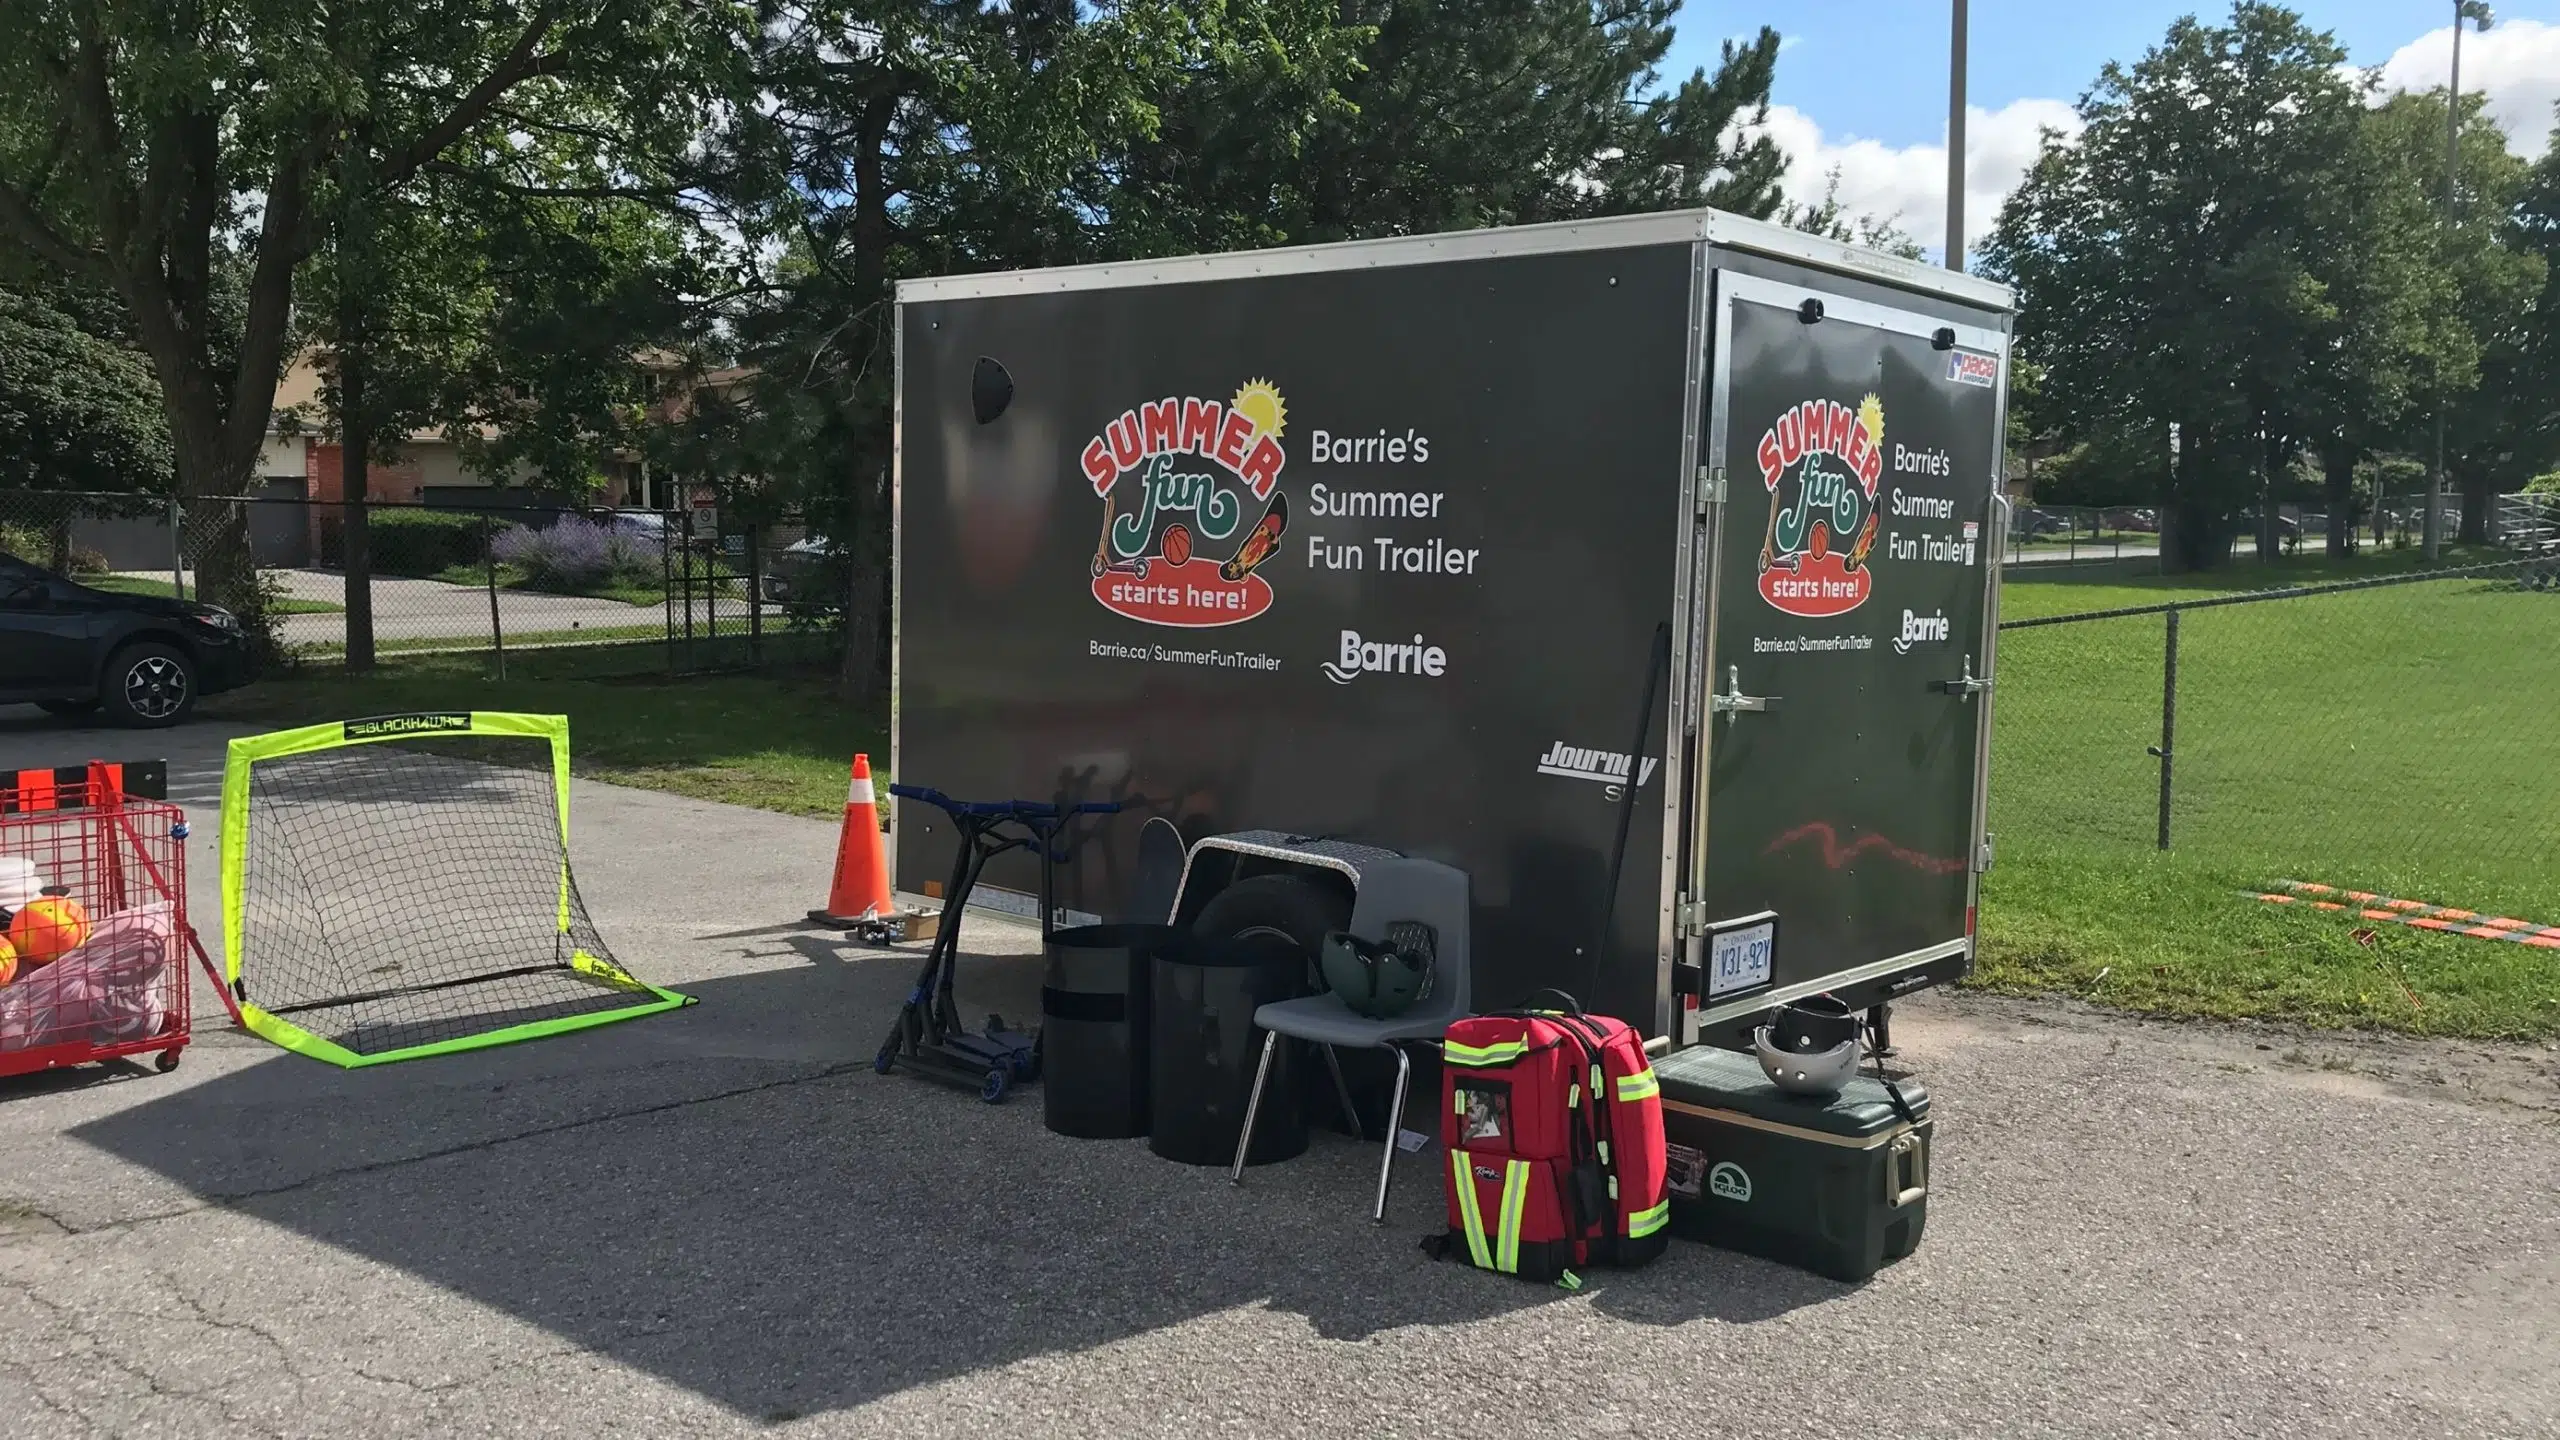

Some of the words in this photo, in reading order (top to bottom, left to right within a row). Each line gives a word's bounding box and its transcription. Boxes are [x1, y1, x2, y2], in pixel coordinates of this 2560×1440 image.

[1081, 397, 1286, 501] SUMMER
[1311, 428, 1429, 463] Barrie's
[1757, 399, 1882, 501] SUMMER
[1894, 443, 1950, 476] Barrie's
[1112, 454, 1240, 557] fun
[1309, 482, 1444, 518] Summer
[1776, 451, 1859, 552] fun
[1891, 487, 1954, 519] Summer
[1308, 535, 1363, 570] Fun
[1374, 537, 1480, 574] Trailer
[1889, 531, 1917, 560] Fun
[1922, 533, 1966, 563] Trailer
[1111, 582, 1179, 605] starts
[1187, 583, 1248, 610] here!
[1772, 574, 1818, 598] starts
[1822, 578, 1859, 598] here!
[1901, 607, 1950, 642] Barrie
[1089, 639, 1282, 671] Barrie.ca/SummerFunTrailer
[1340, 630, 1447, 677] Barrie
[1753, 634, 1873, 654] Barrie.ca/SummerFunTrailer
[365, 716, 452, 734] BLACKHAWK
